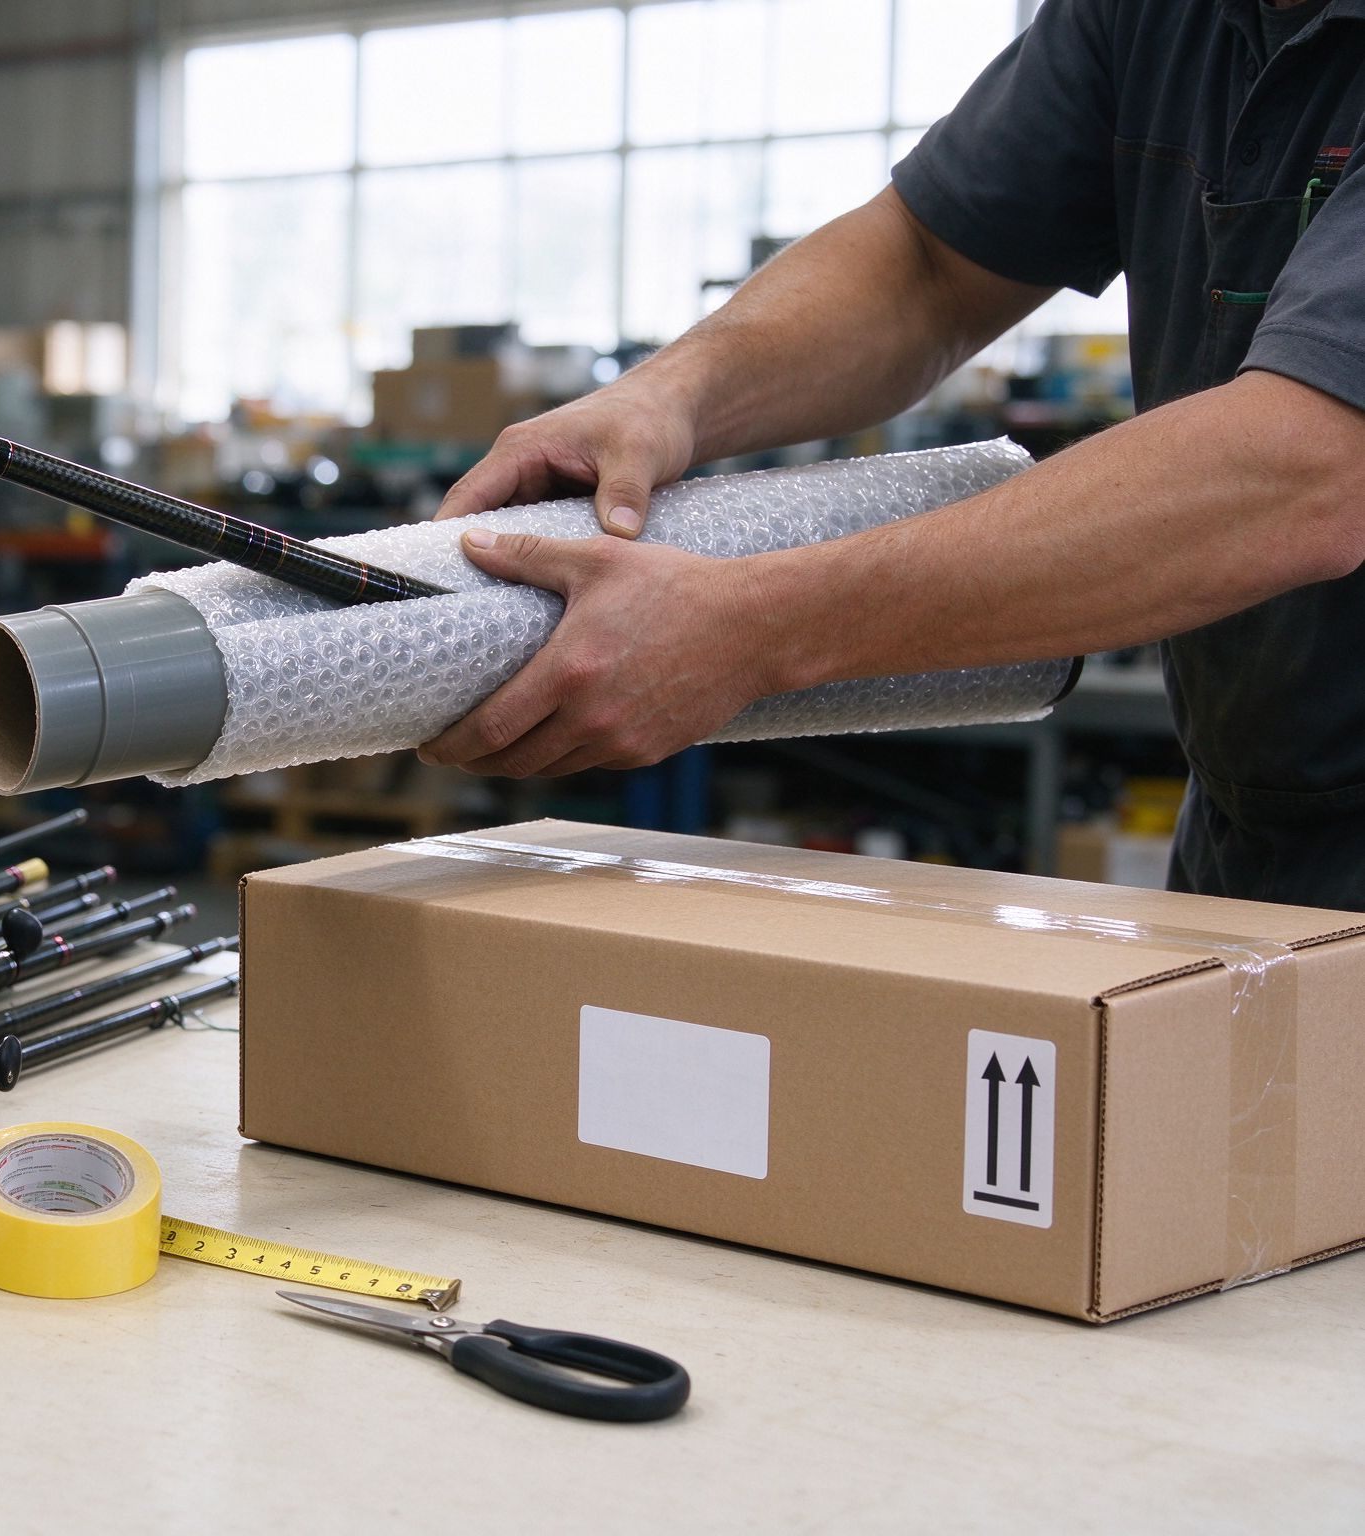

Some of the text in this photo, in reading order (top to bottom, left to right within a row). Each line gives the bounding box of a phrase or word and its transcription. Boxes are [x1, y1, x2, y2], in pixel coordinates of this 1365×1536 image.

[195, 1240, 205, 1252] 2
[225, 1247, 238, 1260] 3
[309, 1265, 322, 1275] 5
[339, 1272, 350, 1281] 6
